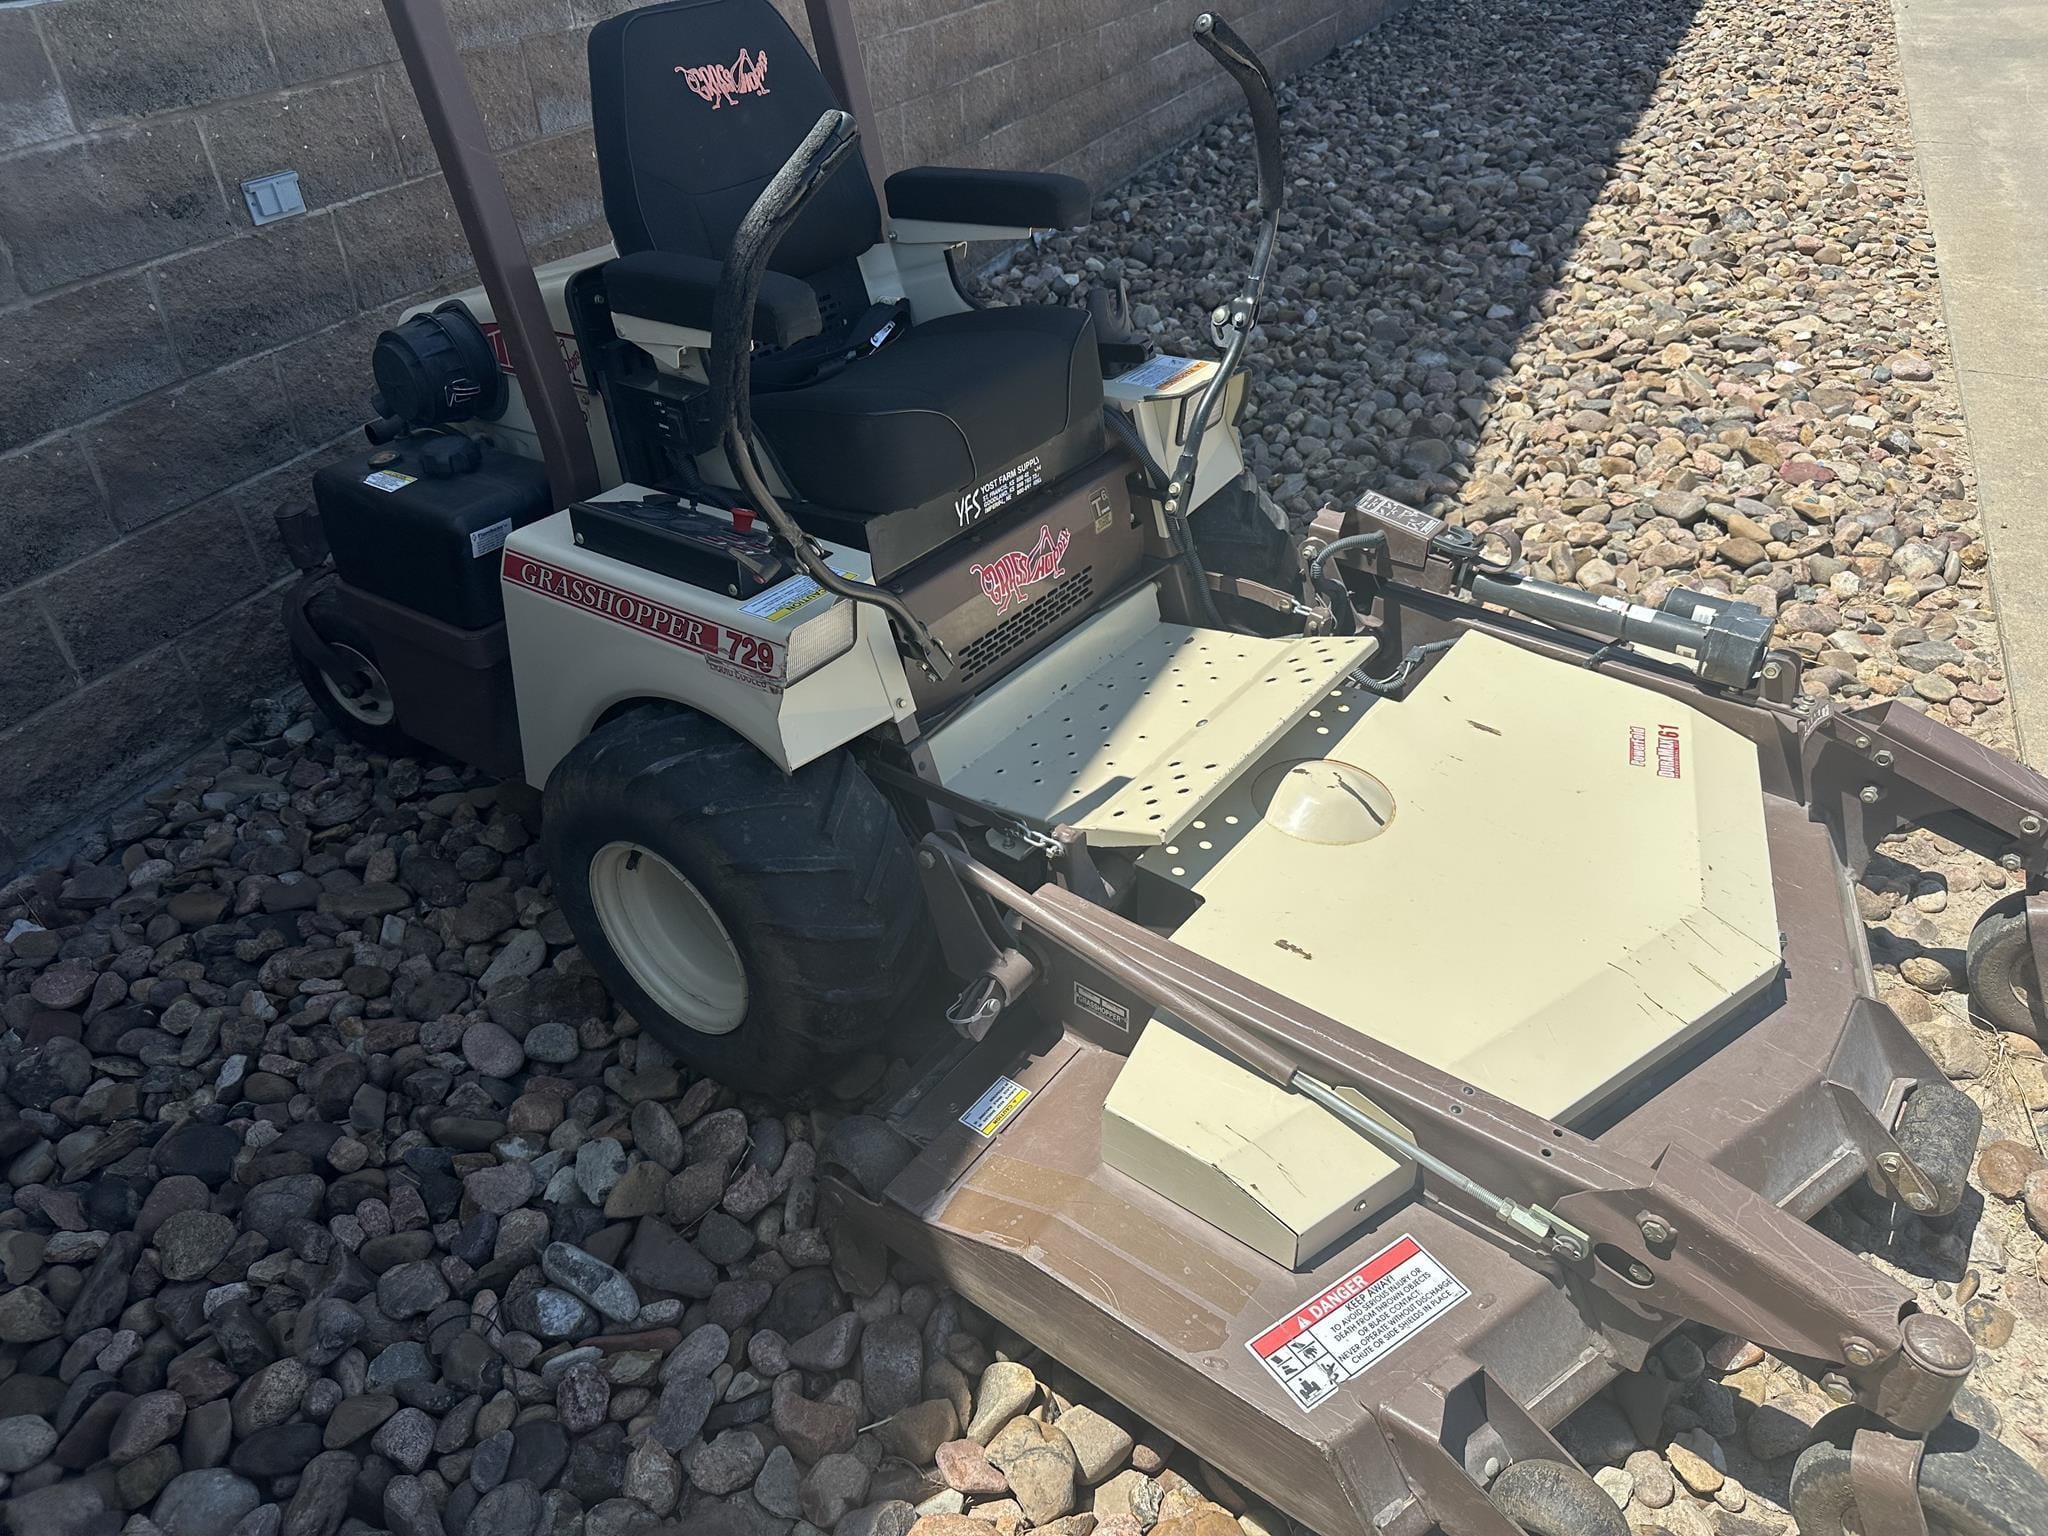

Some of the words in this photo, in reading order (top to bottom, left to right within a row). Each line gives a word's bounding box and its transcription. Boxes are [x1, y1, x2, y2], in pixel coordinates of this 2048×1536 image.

[980, 480, 998, 494] YOST
[999, 468, 1017, 485] FARM
[955, 488, 981, 527] YFS
[519, 561, 705, 645] GRASSHOPPER
[725, 629, 775, 674] 729
[1657, 724, 1680, 738] 61
[992, 1104, 1012, 1124] CAUTION
[1308, 1274, 1370, 1320] DANGER
[1330, 1323, 1342, 1333] TO
[1342, 1308, 1363, 1324] AVOID
[1364, 1291, 1390, 1311] SERIOUS
[1389, 1275, 1410, 1293] INJURY
[1410, 1267, 1422, 1277] OR
[1334, 1325, 1358, 1342] DEATH
[1357, 1310, 1378, 1327] FROM
[1375, 1292, 1404, 1313] THROWN
[1403, 1272, 1432, 1294] OBJECTS
[1344, 1293, 1366, 1312] KEEP
[1367, 1274, 1396, 1298] AWAY!
[1338, 1344, 1361, 1362] NEVER
[1360, 1324, 1389, 1346] OPERATE
[1388, 1304, 1417, 1325] WITHOUT
[1417, 1278, 1453, 1306] DISCHARGE
[1351, 1346, 1374, 1364] CHUTE
[1373, 1338, 1385, 1349] OR
[1384, 1327, 1399, 1341] SIDE
[1398, 1310, 1425, 1331] SHIELDS
[1423, 1304, 1432, 1312] IN
[1357, 1326, 1369, 1337] OR
[1368, 1312, 1388, 1330] BLADE
